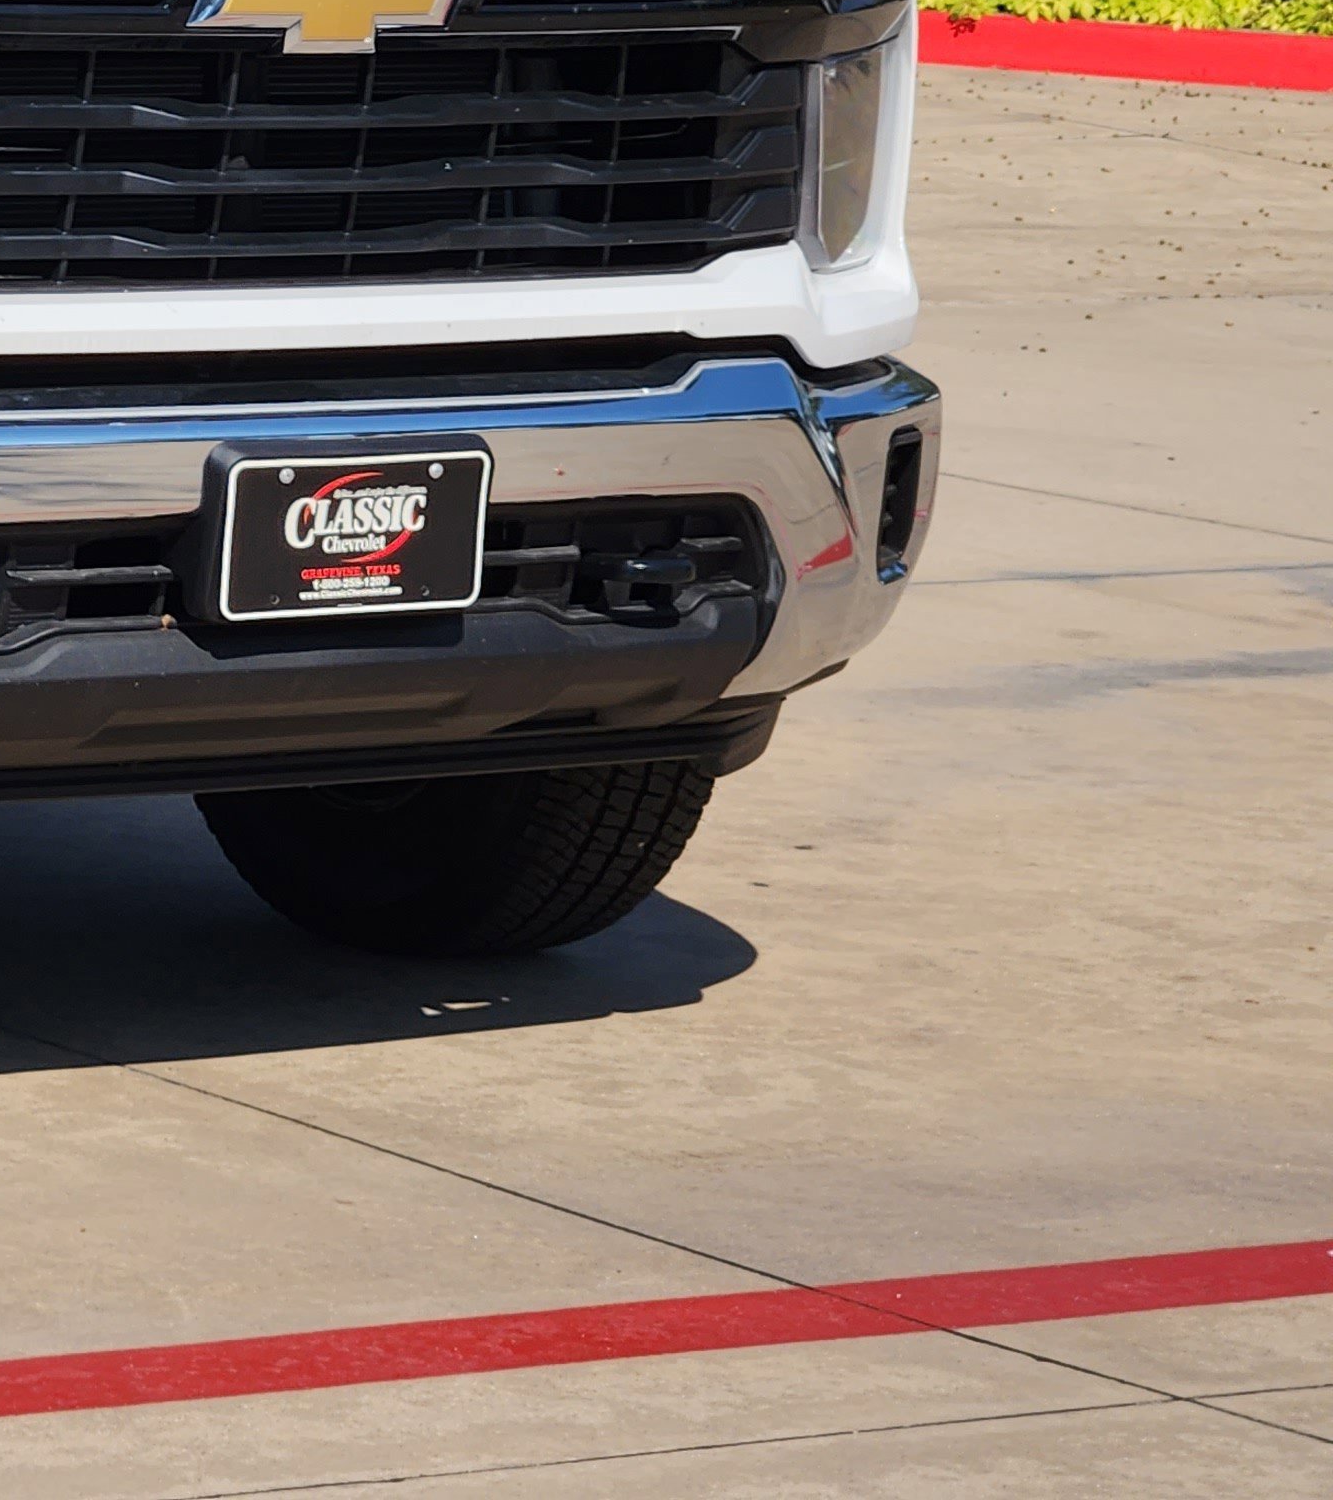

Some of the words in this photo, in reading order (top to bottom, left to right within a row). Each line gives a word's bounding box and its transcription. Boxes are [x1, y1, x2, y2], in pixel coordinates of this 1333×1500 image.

[285, 495, 427, 549] CLASSIC
[322, 533, 387, 554] Chevrolet
[366, 564, 402, 577] TEXAS
